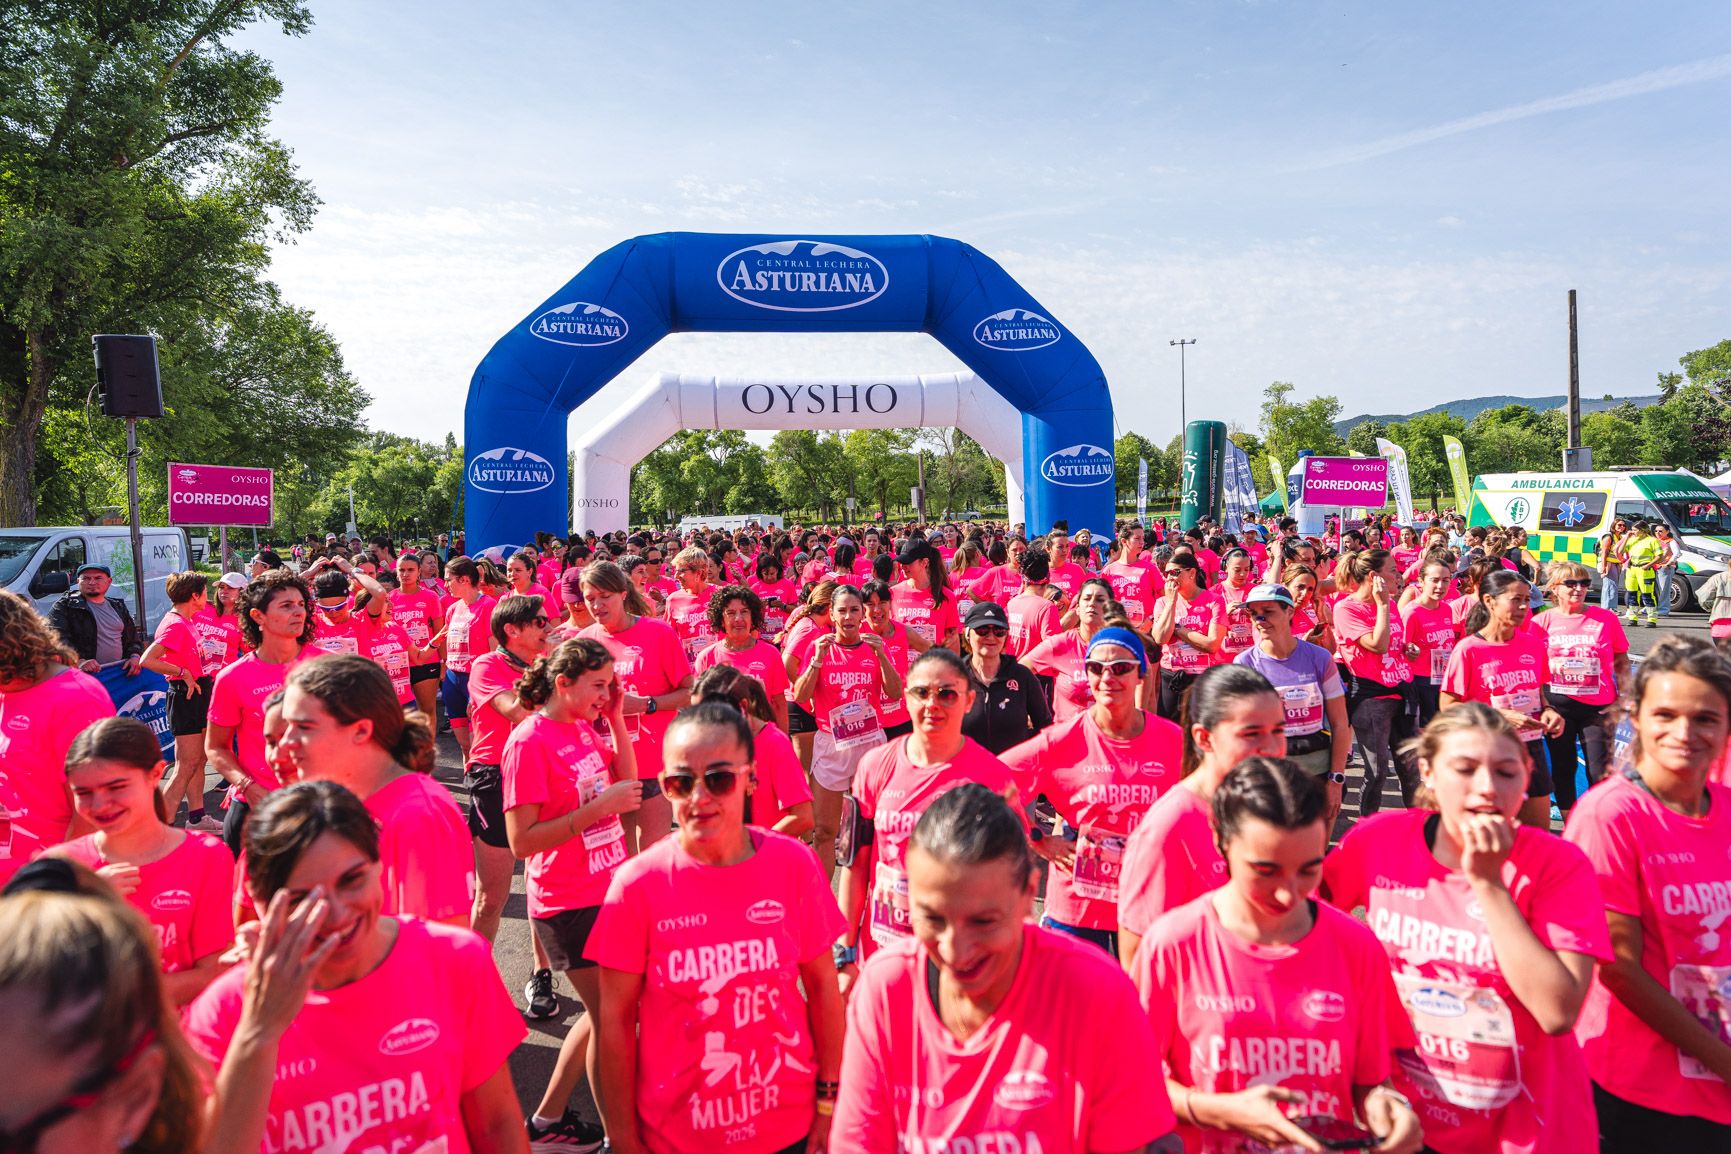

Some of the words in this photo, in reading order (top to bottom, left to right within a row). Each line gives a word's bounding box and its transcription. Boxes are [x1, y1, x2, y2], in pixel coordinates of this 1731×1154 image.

[757, 259, 812, 268] CENTRAL
[816, 261, 870, 269] LECHERA
[731, 260, 876, 293] ASTURIANA
[536, 318, 621, 337] ASTURIANA
[980, 324, 1056, 341] ASTURIANA
[742, 384, 898, 414] OYSHO
[472, 464, 549, 483] ASTURIANA
[1047, 461, 1112, 477] ASTURIANA
[1352, 464, 1385, 472] OYSHO
[231, 475, 268, 484] OYSHO
[1306, 480, 1385, 492] CORREDORAS
[1511, 480, 1594, 489] AMBULANCIA
[172, 492, 268, 507] CORREDORAS
[578, 498, 619, 508] OYSHO
[154, 545, 180, 559] AXOR
[394, 610, 424, 621] CARRERA
[898, 608, 931, 619] CARRERA
[196, 622, 228, 639] CARRERA
[1549, 634, 1597, 645] CARRERA
[829, 672, 873, 685] CARRERA
[1487, 670, 1537, 689] CARRERA
[1565, 674, 1585, 682] 016
[253, 682, 282, 695] OYSHO
[1287, 708, 1310, 718] 016
[848, 720, 865, 731] 016
[1087, 784, 1159, 805] CARRERA
[1375, 875, 1426, 901] OYSHO
[657, 913, 708, 933] OYSHO
[1375, 908, 1495, 968] CARRERA
[668, 937, 779, 983] CARRERA
[1196, 994, 1256, 1013] OYSHO
[1210, 1034, 1342, 1077] CARRERA
[1420, 1034, 1470, 1062] 016
[262, 1071, 429, 1154] CARRERA
[692, 1084, 779, 1130] MUJER
[726, 1123, 756, 1145] 2026
